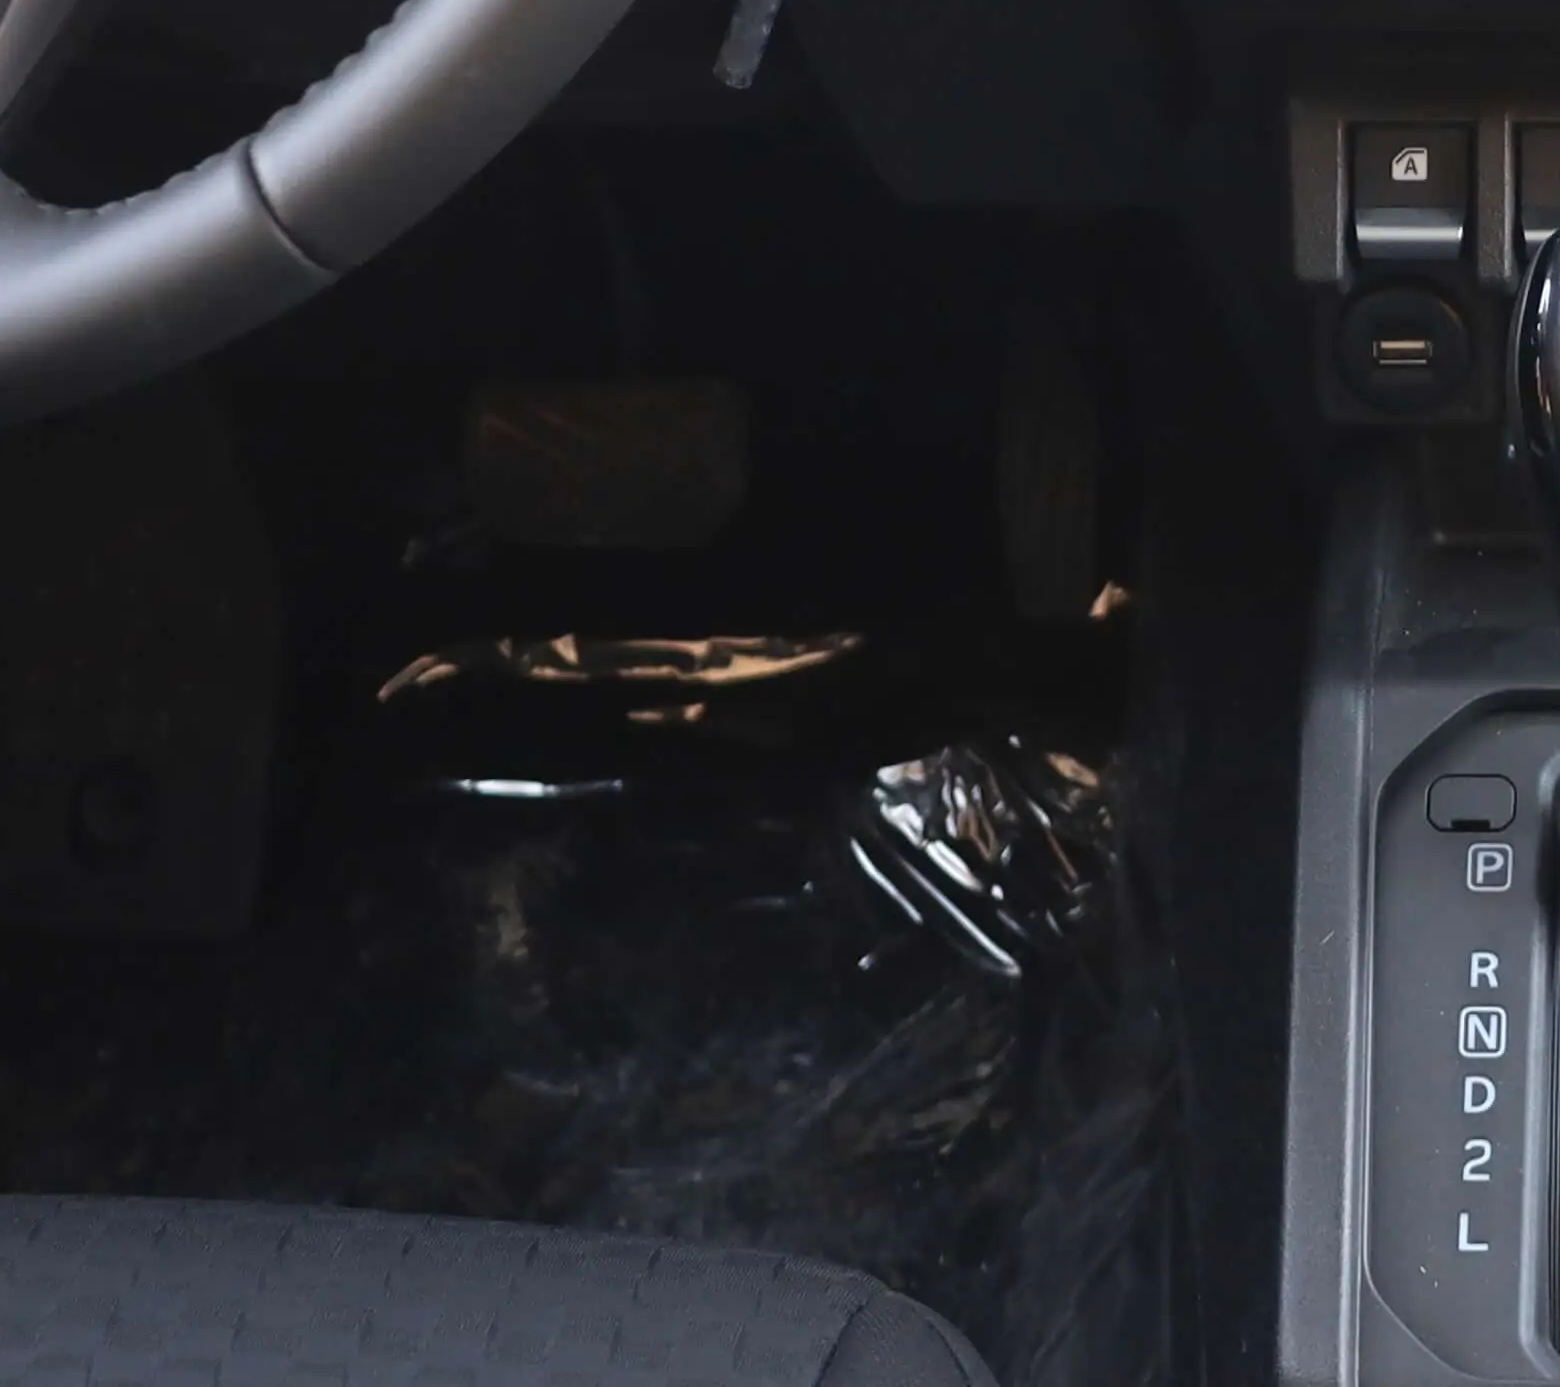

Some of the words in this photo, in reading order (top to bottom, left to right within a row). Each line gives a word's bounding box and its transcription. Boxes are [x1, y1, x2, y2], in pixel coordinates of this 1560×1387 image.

[1475, 851, 1505, 884] P
[1470, 952, 1499, 988] R
[1468, 1014, 1498, 1050] N
[1463, 1076, 1497, 1114] D
[1462, 1138, 1492, 1182] 2
[1458, 1212, 1489, 1251] L
